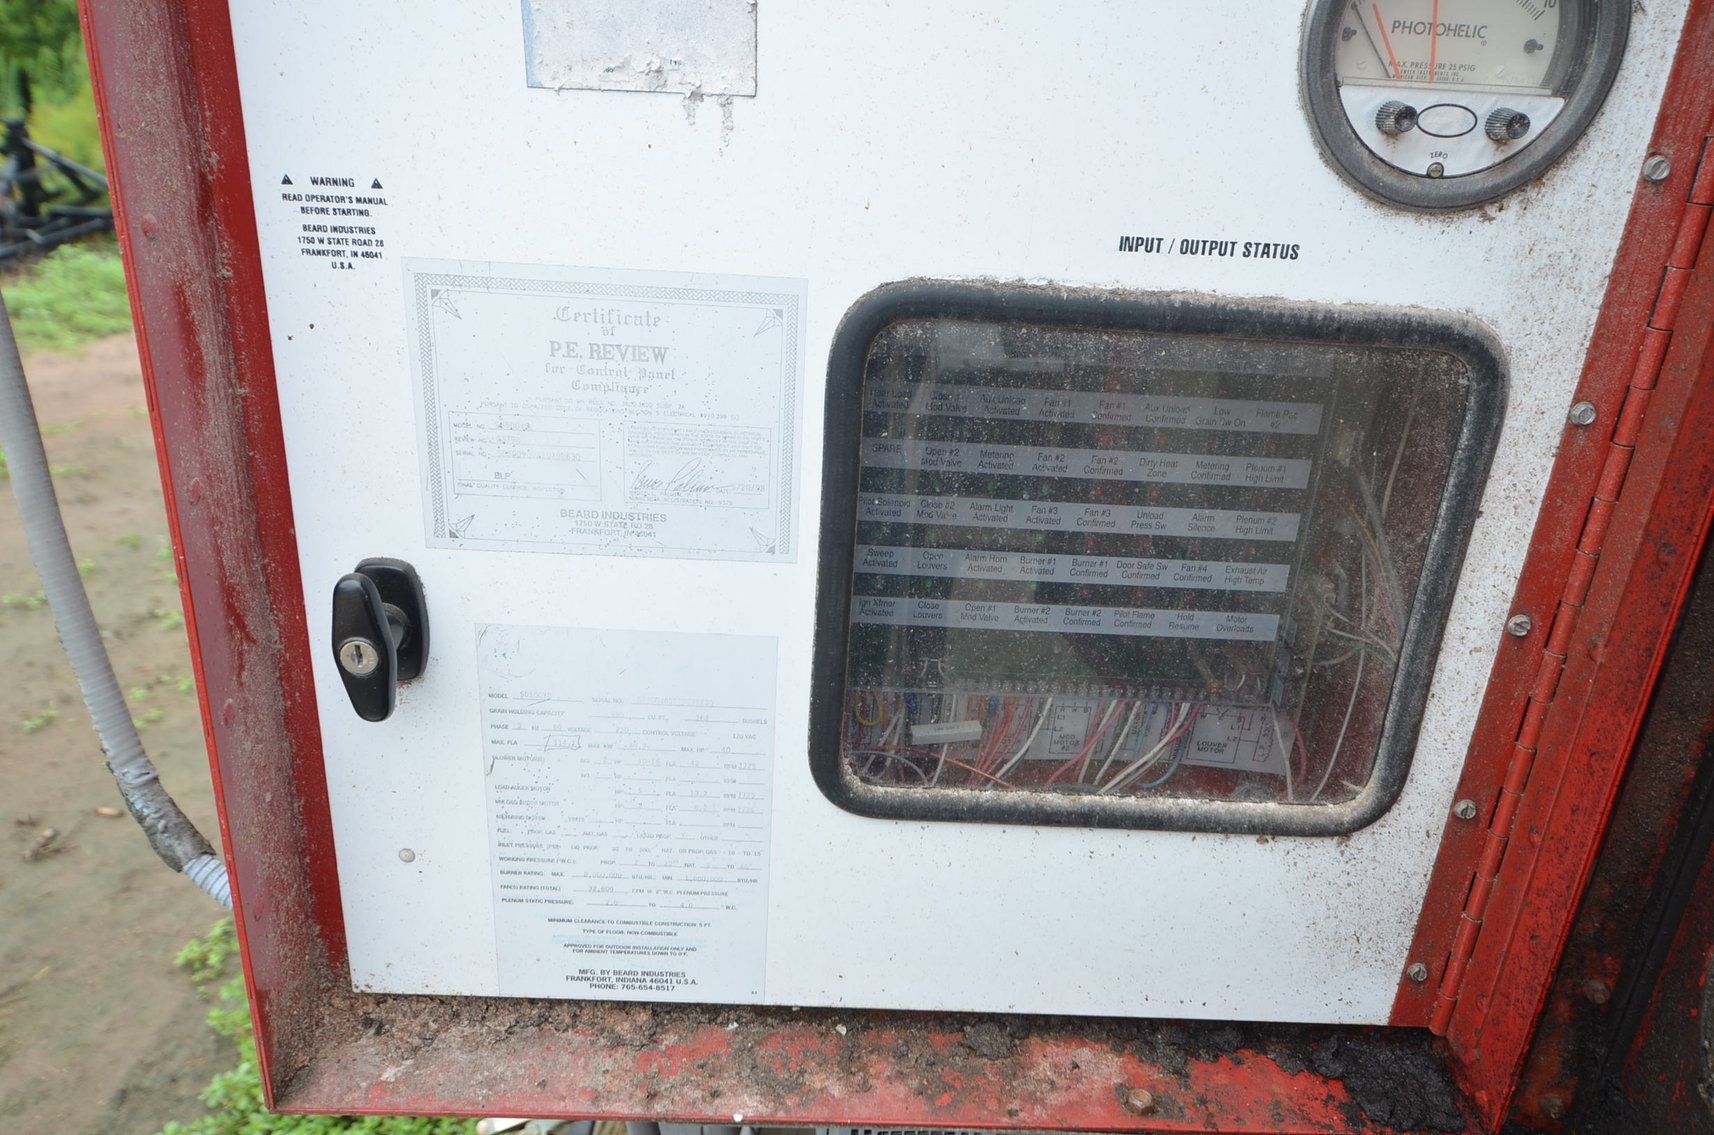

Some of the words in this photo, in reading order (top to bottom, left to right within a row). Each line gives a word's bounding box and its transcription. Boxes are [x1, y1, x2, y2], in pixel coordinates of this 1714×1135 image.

[1391, 20, 1488, 39] PHOTOHELIC
[1459, 64, 1476, 72] PSIG
[1430, 151, 1448, 160] ZERO
[310, 176, 355, 187] WARNING
[282, 193, 302, 201] READ
[305, 194, 353, 203] OPERATOR'S
[356, 197, 388, 205] MANUAL
[300, 207, 330, 215] BEFORE
[333, 208, 372, 217] STARTING.
[303, 224, 328, 232] BEARD
[330, 226, 376, 234] INDUSTRIES
[297, 236, 315, 244] 1750
[1119, 236, 1164, 253] INPUT
[1180, 239, 1237, 257] OUTPUT
[1242, 241, 1300, 260] STATUS
[301, 249, 348, 258] FRANKFORT,
[556, 306, 661, 327] Certificate
[602, 327, 616, 336] of
[549, 340, 583, 359] P.E.
[588, 343, 670, 366] REVIEW
[545, 362, 565, 374] for
[577, 364, 627, 378] Control
[639, 368, 676, 381] Panel
[1099, 400, 1114, 409] Fan
[872, 444, 902, 453] SPARE
[1038, 453, 1053, 461] Fan
[1091, 456, 1106, 464] Fan
[1108, 457, 1118, 465] #2
[1139, 458, 1157, 468] Dirty
[1159, 459, 1178, 468] Heat
[1196, 461, 1229, 471] Metering
[1084, 466, 1123, 476] Confirmed
[1147, 469, 1167, 478] Zone
[1191, 471, 1231, 480] Confirmed
[494, 472, 511, 480] BLP
[1245, 474, 1263, 483] High
[1265, 474, 1284, 483] Limit
[866, 509, 901, 517] Activated
[970, 503, 993, 511] Alarm
[995, 504, 1013, 514] Light
[1032, 506, 1046, 514] Fan
[1048, 506, 1058, 514] #3
[1084, 509, 1099, 517] Fan
[1101, 509, 1111, 517] #3
[560, 509, 599, 519] BEARD
[602, 511, 667, 522] INDUSTRIES
[973, 513, 1008, 522] Activated
[1137, 512, 1164, 520] Unload
[1192, 514, 1214, 522] Alarm
[1236, 515, 1264, 524] Plenum
[1026, 516, 1061, 525] Activated
[1077, 518, 1116, 528] Confirmed
[1131, 521, 1153, 529] Press
[1155, 522, 1167, 530] Sw
[1188, 523, 1215, 532] Silence
[1235, 526, 1253, 536] High
[1256, 527, 1273, 535] Limit
[868, 550, 894, 560] Sweep
[965, 554, 988, 562] Alarm
[990, 555, 1008, 563] Horn
[863, 559, 898, 567] Activated
[1020, 557, 1045, 565] Burner
[1072, 559, 1098, 568] Burner
[918, 562, 947, 570] Louvers
[968, 564, 1002, 572] Activated
[1116, 561, 1135, 569] Door
[1137, 562, 1155, 571] Safe
[1181, 564, 1195, 572] Fan
[1197, 565, 1207, 573] #4
[1225, 566, 1255, 575] Exhaust
[1257, 567, 1268, 575] Air
[1020, 567, 1054, 576] Activated
[1070, 569, 1108, 578] Confirmed
[1122, 571, 1160, 580] Confirmed
[1174, 574, 1212, 583] Confirmed
[1225, 576, 1243, 586] High
[1245, 577, 1264, 586] Temp
[918, 602, 940, 610] Close
[965, 604, 985, 614] Open
[1014, 606, 1039, 614] Burner
[1041, 607, 1051, 615] #2
[1065, 608, 1091, 617] Burner
[1114, 610, 1130, 618] Pilot
[1132, 611, 1155, 620] Flame
[1177, 613, 1194, 621] Hold
[1015, 616, 1048, 624] Activated
[1063, 618, 1100, 626] Confirmed
[1226, 615, 1247, 623] Motor
[1114, 619, 1151, 629] Confirmed
[1216, 624, 1253, 633] Overloads
[641, 970, 686, 978] INDUSTRIES
[566, 976, 613, 984] FRANKFORT,
[621, 984, 675, 992] 765-654-8517
